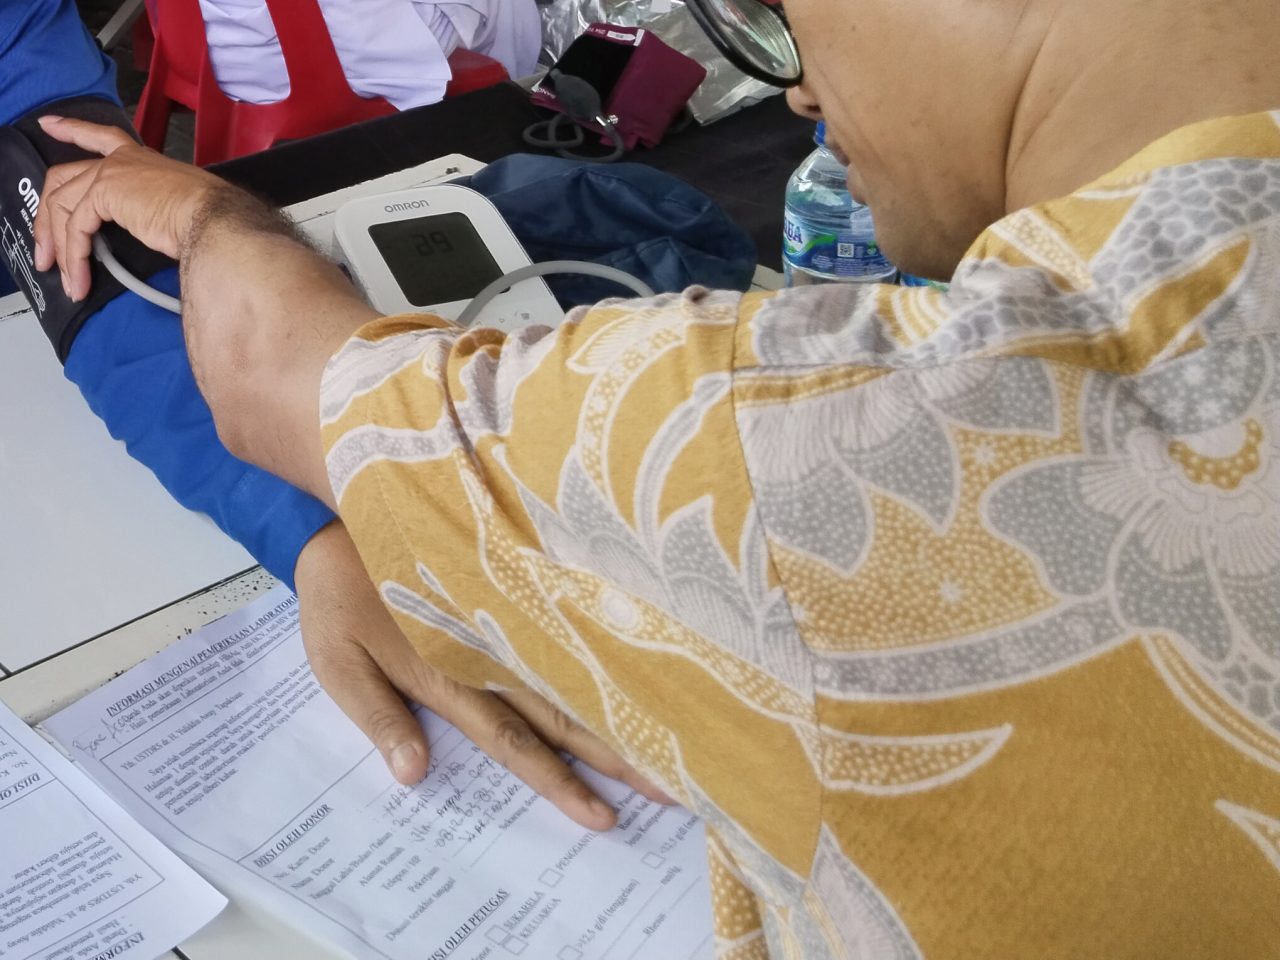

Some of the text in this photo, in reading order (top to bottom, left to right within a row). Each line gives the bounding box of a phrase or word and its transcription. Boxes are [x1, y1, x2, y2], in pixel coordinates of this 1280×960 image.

[384, 199, 430, 213] OMRON
[106, 682, 156, 717] INFORMASI
[153, 656, 201, 688] MENGENAI
[197, 629, 250, 662] PEMERIKSAAN
[12, 772, 40, 793] DIISI
[253, 804, 332, 868] DIISI OLEH DONOR
[444, 890, 509, 950] OLEH PETUGAS
